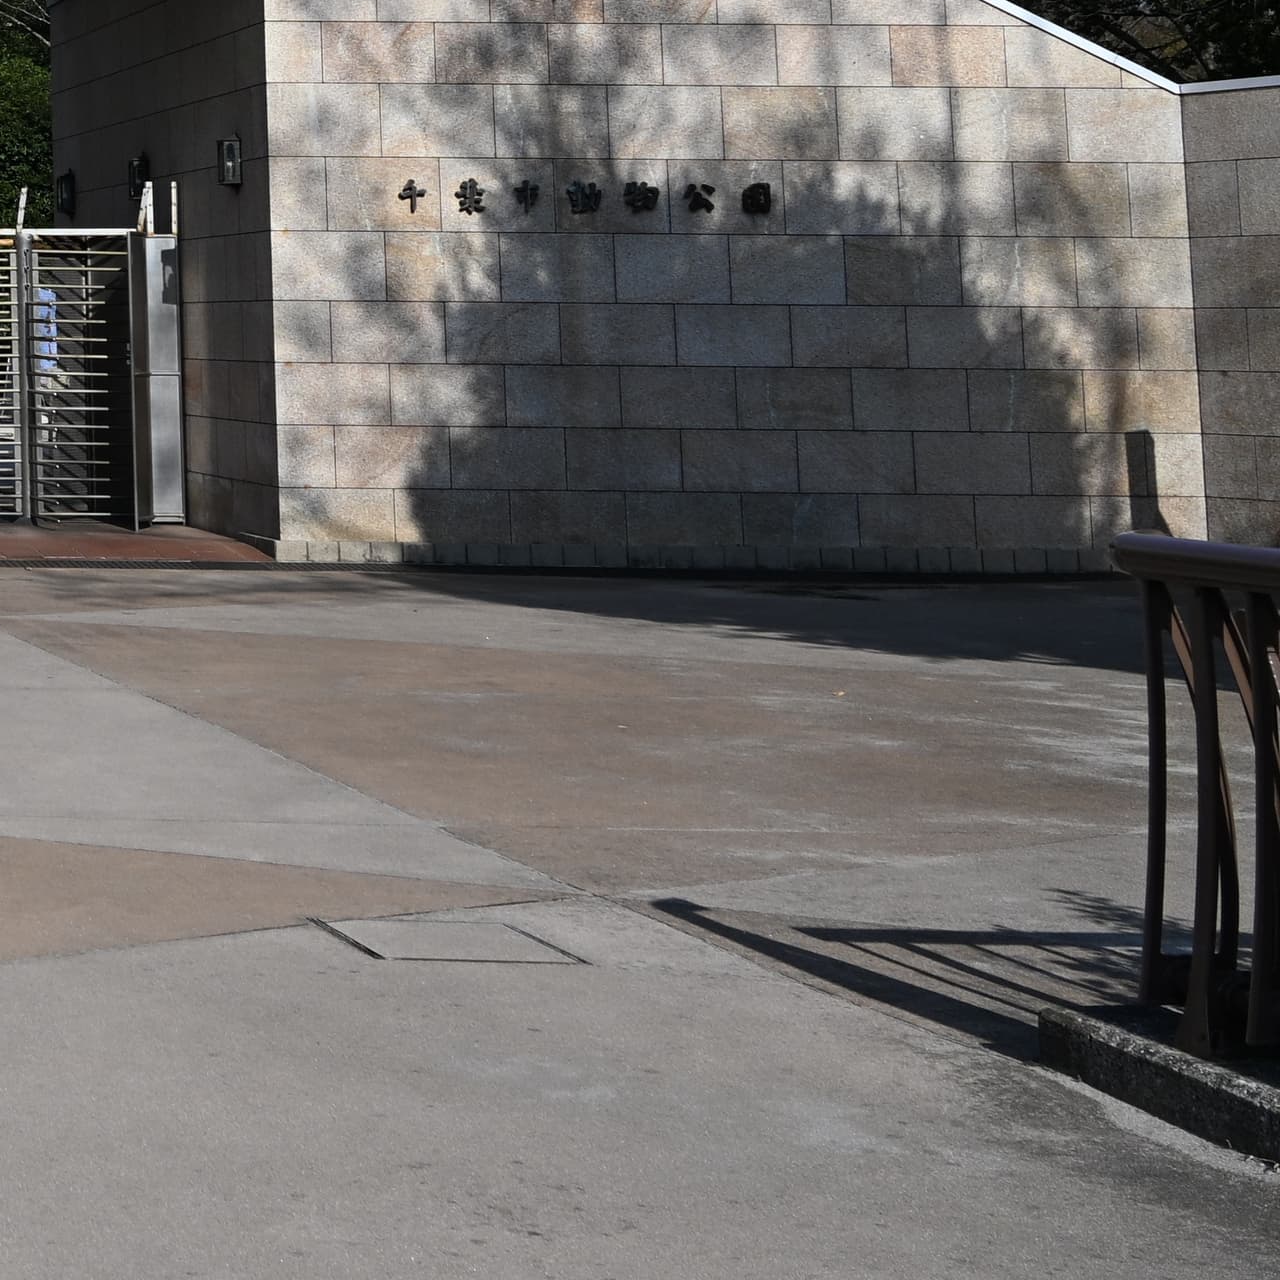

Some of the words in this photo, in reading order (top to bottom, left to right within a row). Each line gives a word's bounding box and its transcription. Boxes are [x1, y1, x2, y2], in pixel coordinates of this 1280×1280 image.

[398, 177, 772, 215] 千葉市動物公園
